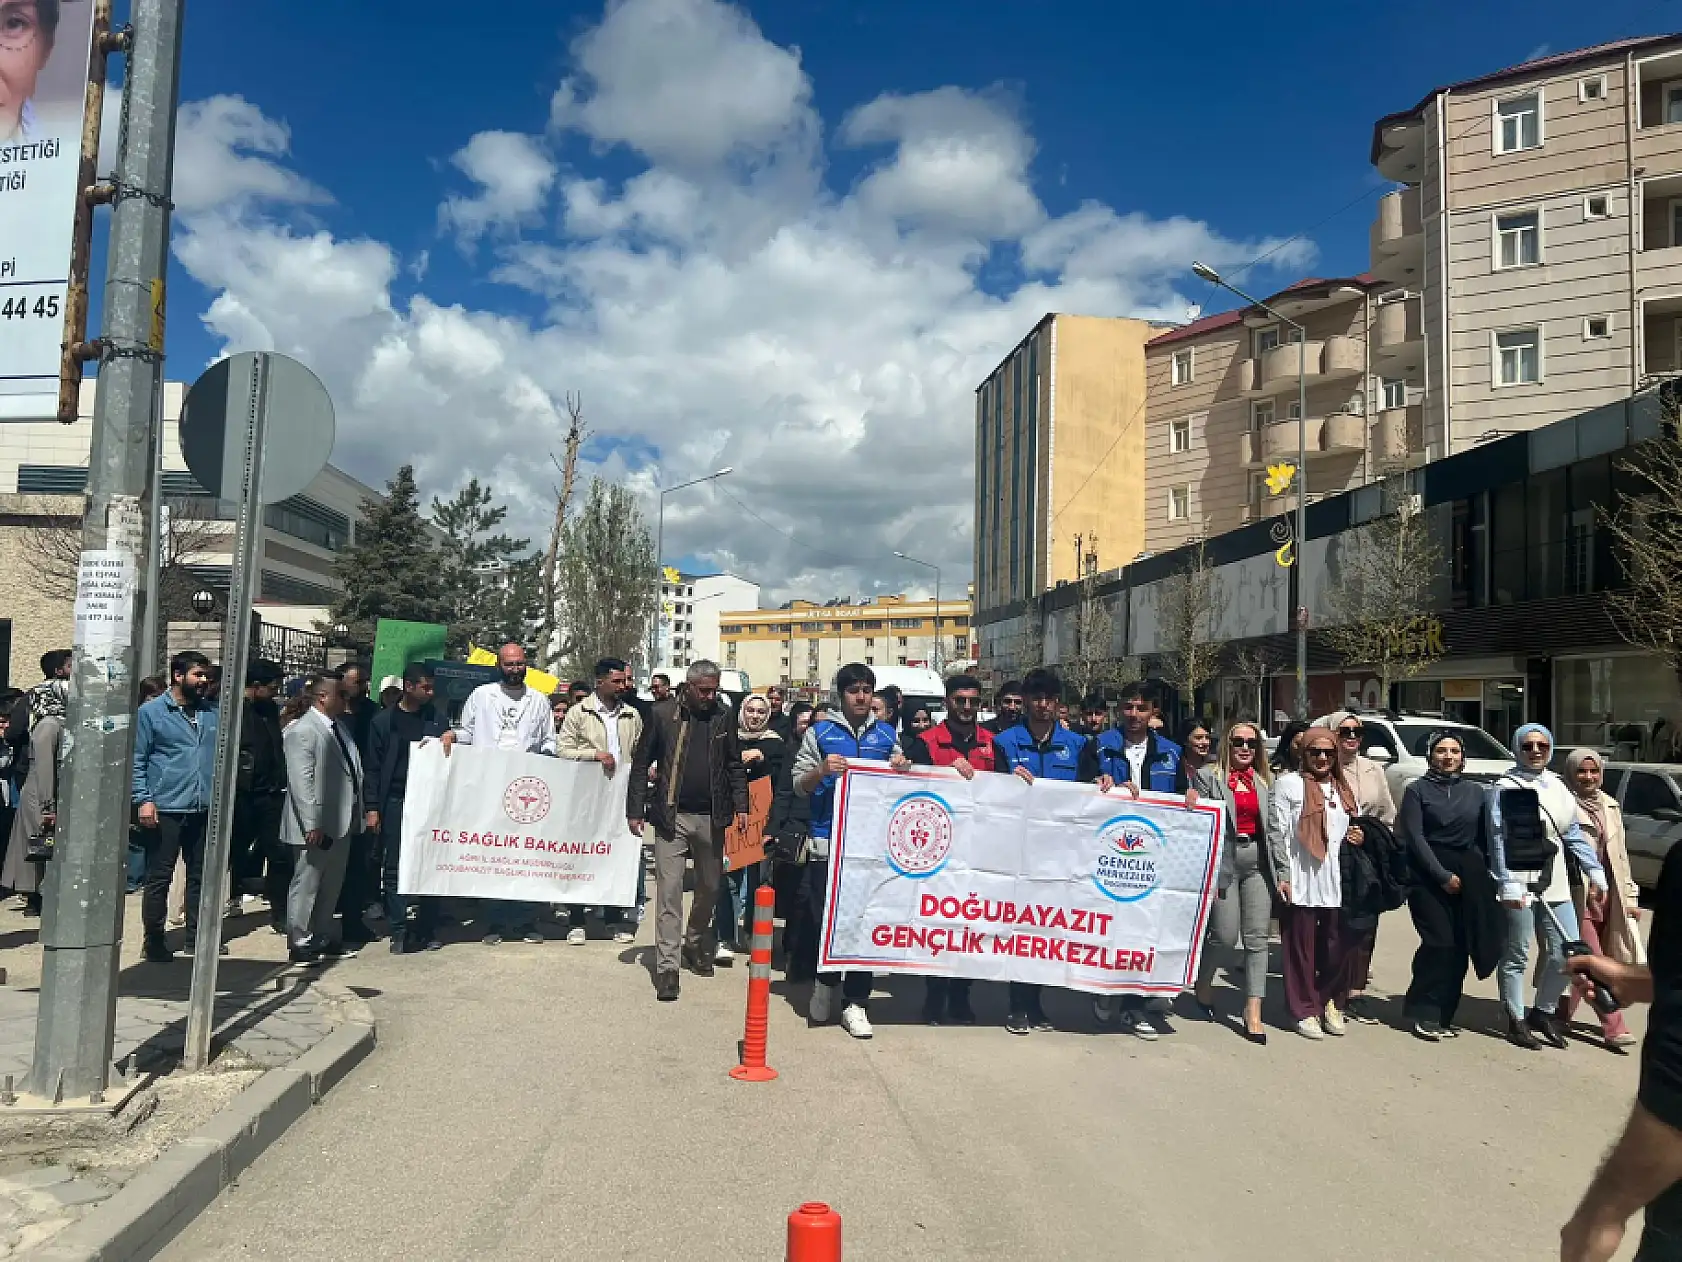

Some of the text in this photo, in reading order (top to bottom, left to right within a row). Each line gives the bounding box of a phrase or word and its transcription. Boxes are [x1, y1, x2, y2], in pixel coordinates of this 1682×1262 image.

[0, 138, 60, 164] STETİĞİ
[2, 295, 59, 320] 44 45
[432, 829, 612, 855] T.C. SAĞLIK BAKANLIĞI
[1097, 855, 1155, 873] GENÇLİK
[920, 891, 1114, 936] DOĞUBAYAZIT
[871, 924, 1155, 973] GENÇLİK MERKEZLERİ
